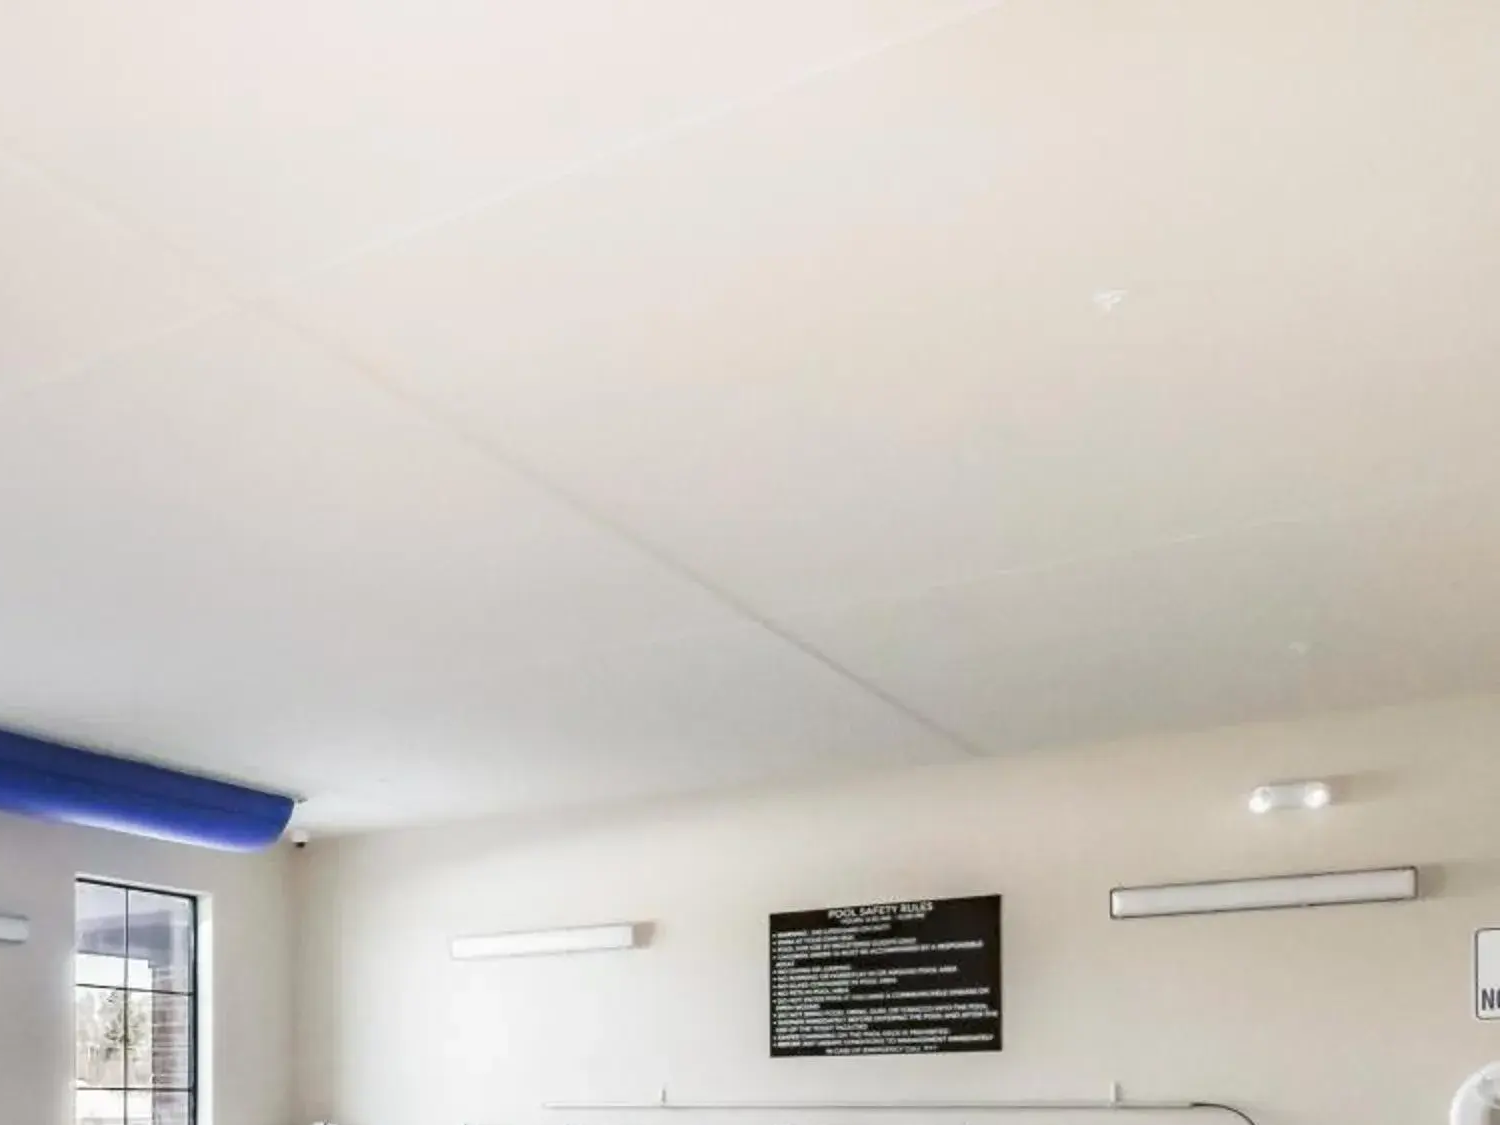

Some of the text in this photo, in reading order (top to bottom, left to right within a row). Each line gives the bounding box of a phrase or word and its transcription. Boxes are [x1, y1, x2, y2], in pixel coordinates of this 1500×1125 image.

[827, 901, 934, 919] POOL SAFETY RULES
